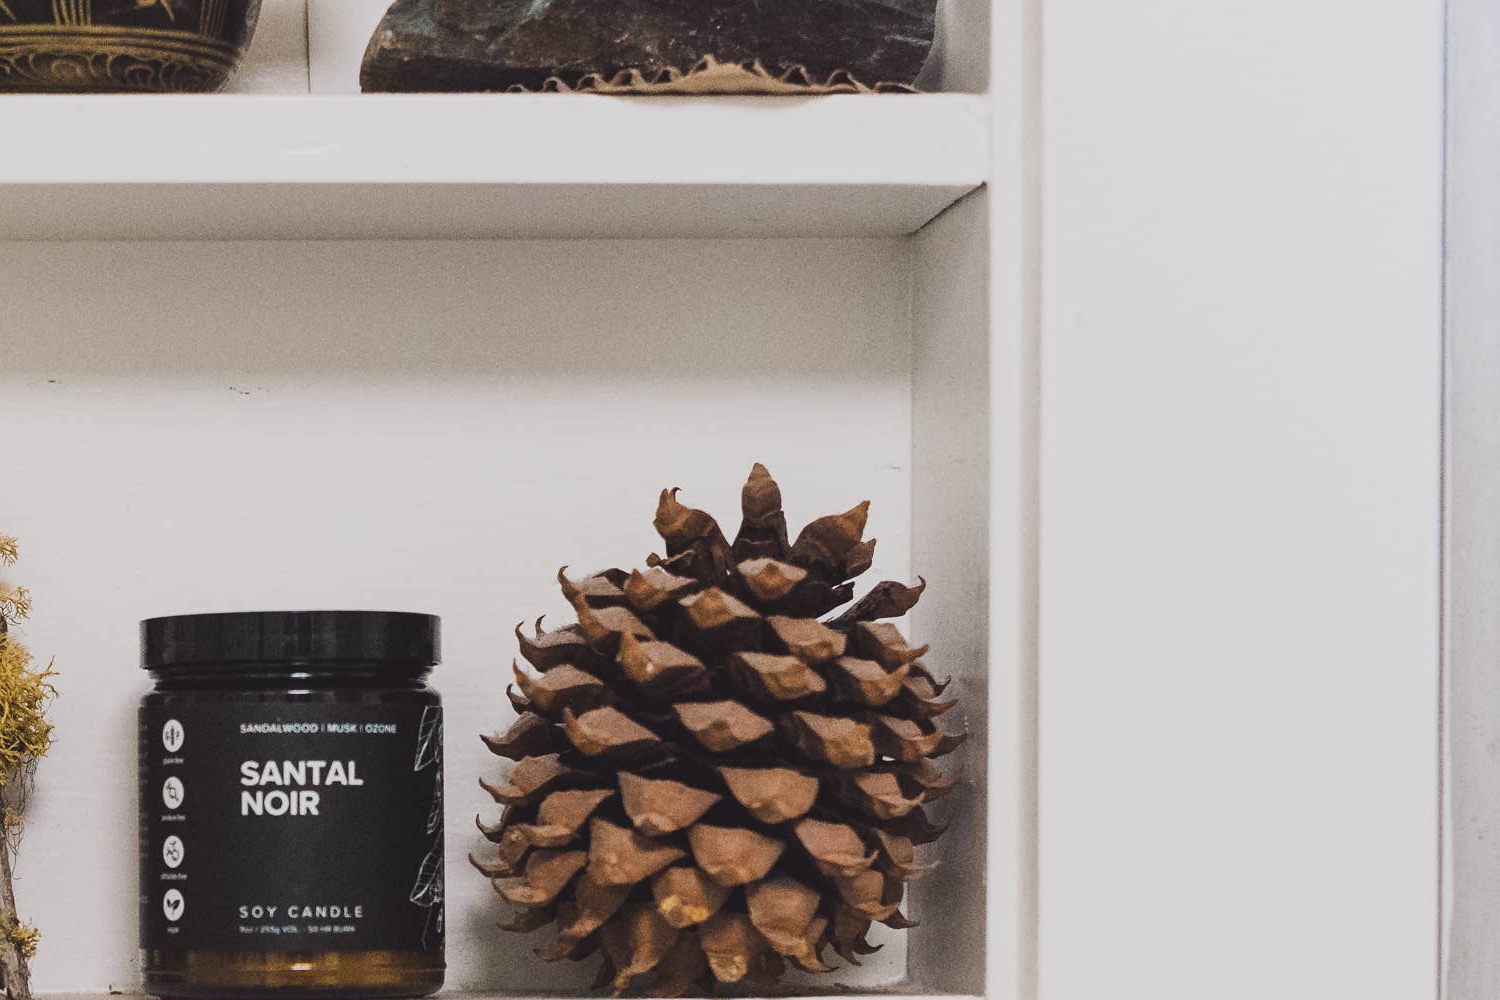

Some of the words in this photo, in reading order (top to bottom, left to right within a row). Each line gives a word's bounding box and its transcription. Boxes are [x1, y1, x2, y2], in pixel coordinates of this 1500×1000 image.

[239, 723, 319, 734] SANDALWOOD
[327, 723, 358, 734] MUSK
[364, 723, 397, 734] OZONE
[240, 760, 364, 786] SANTAL
[241, 790, 321, 816] NOIR
[239, 905, 278, 918] SOY
[287, 905, 364, 918] CANDLE
